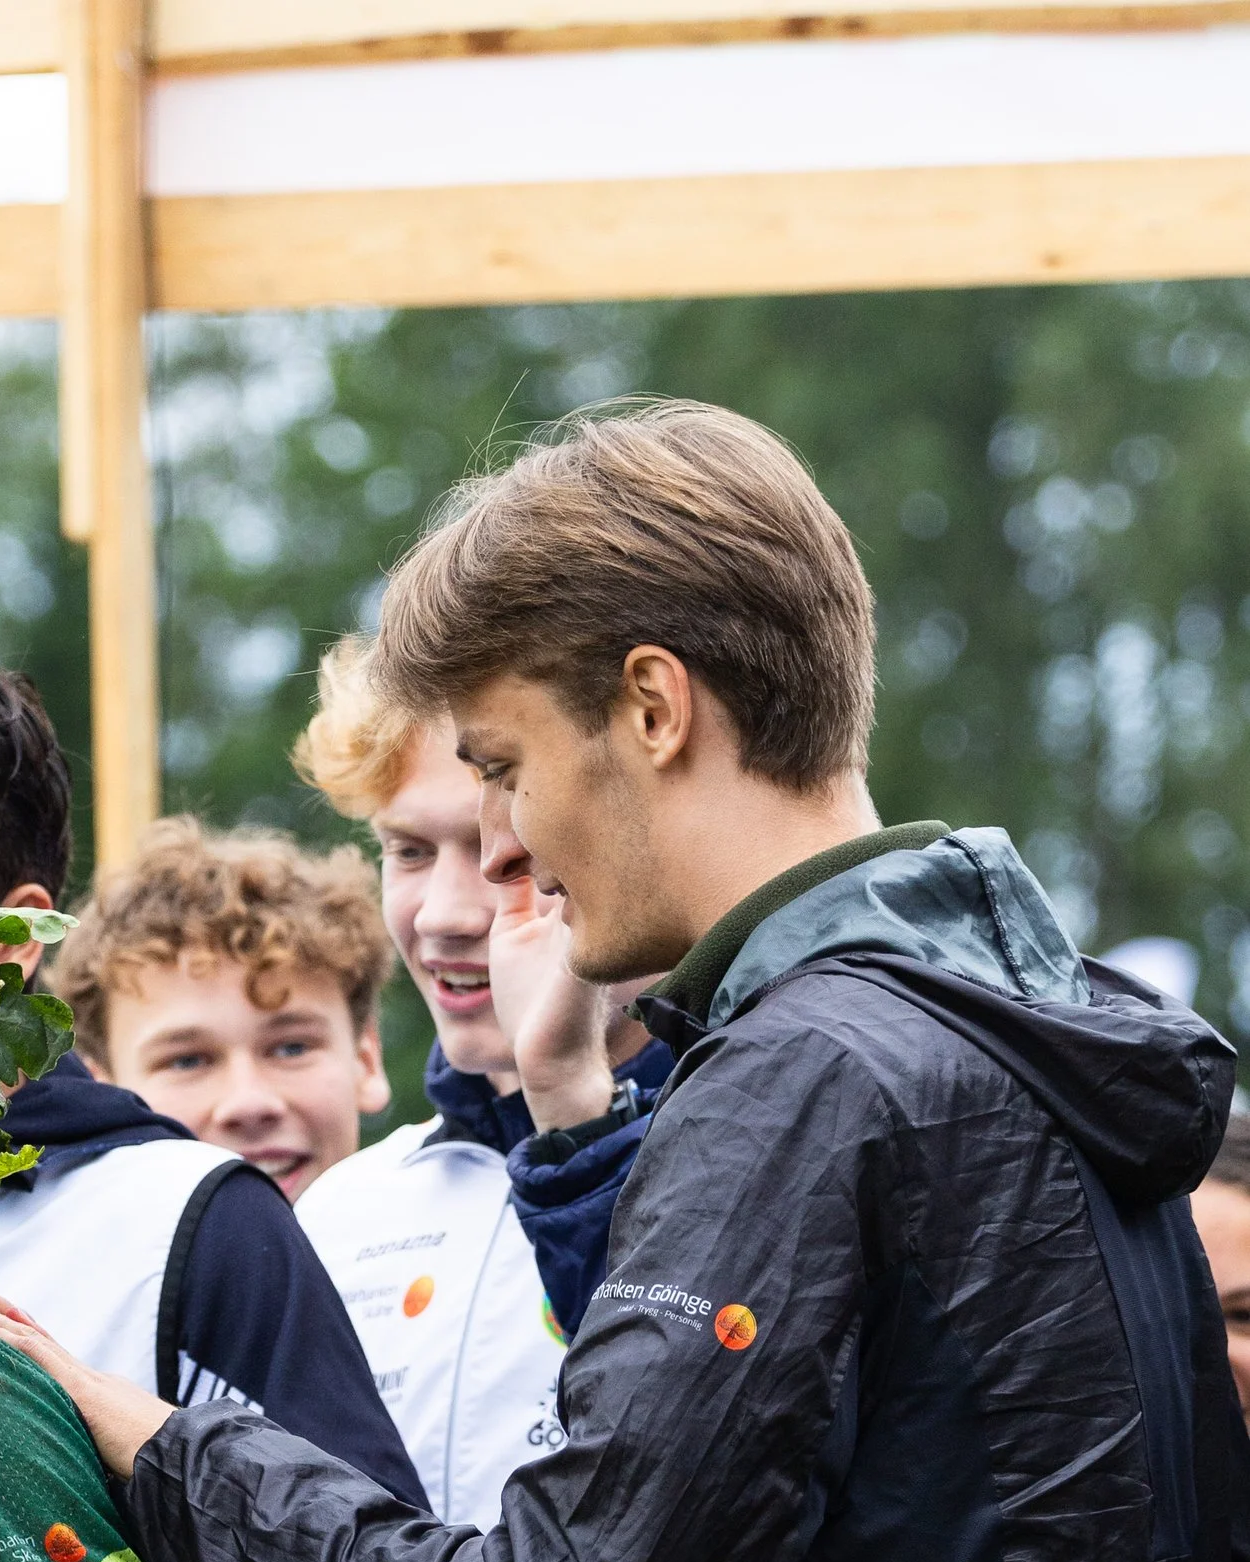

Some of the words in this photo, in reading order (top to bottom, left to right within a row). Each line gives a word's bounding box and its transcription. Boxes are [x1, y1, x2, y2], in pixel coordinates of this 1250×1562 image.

[648, 1283, 712, 1317] Göinge
[637, 1303, 659, 1317] Trygg
[664, 1310, 703, 1332] Personlig
